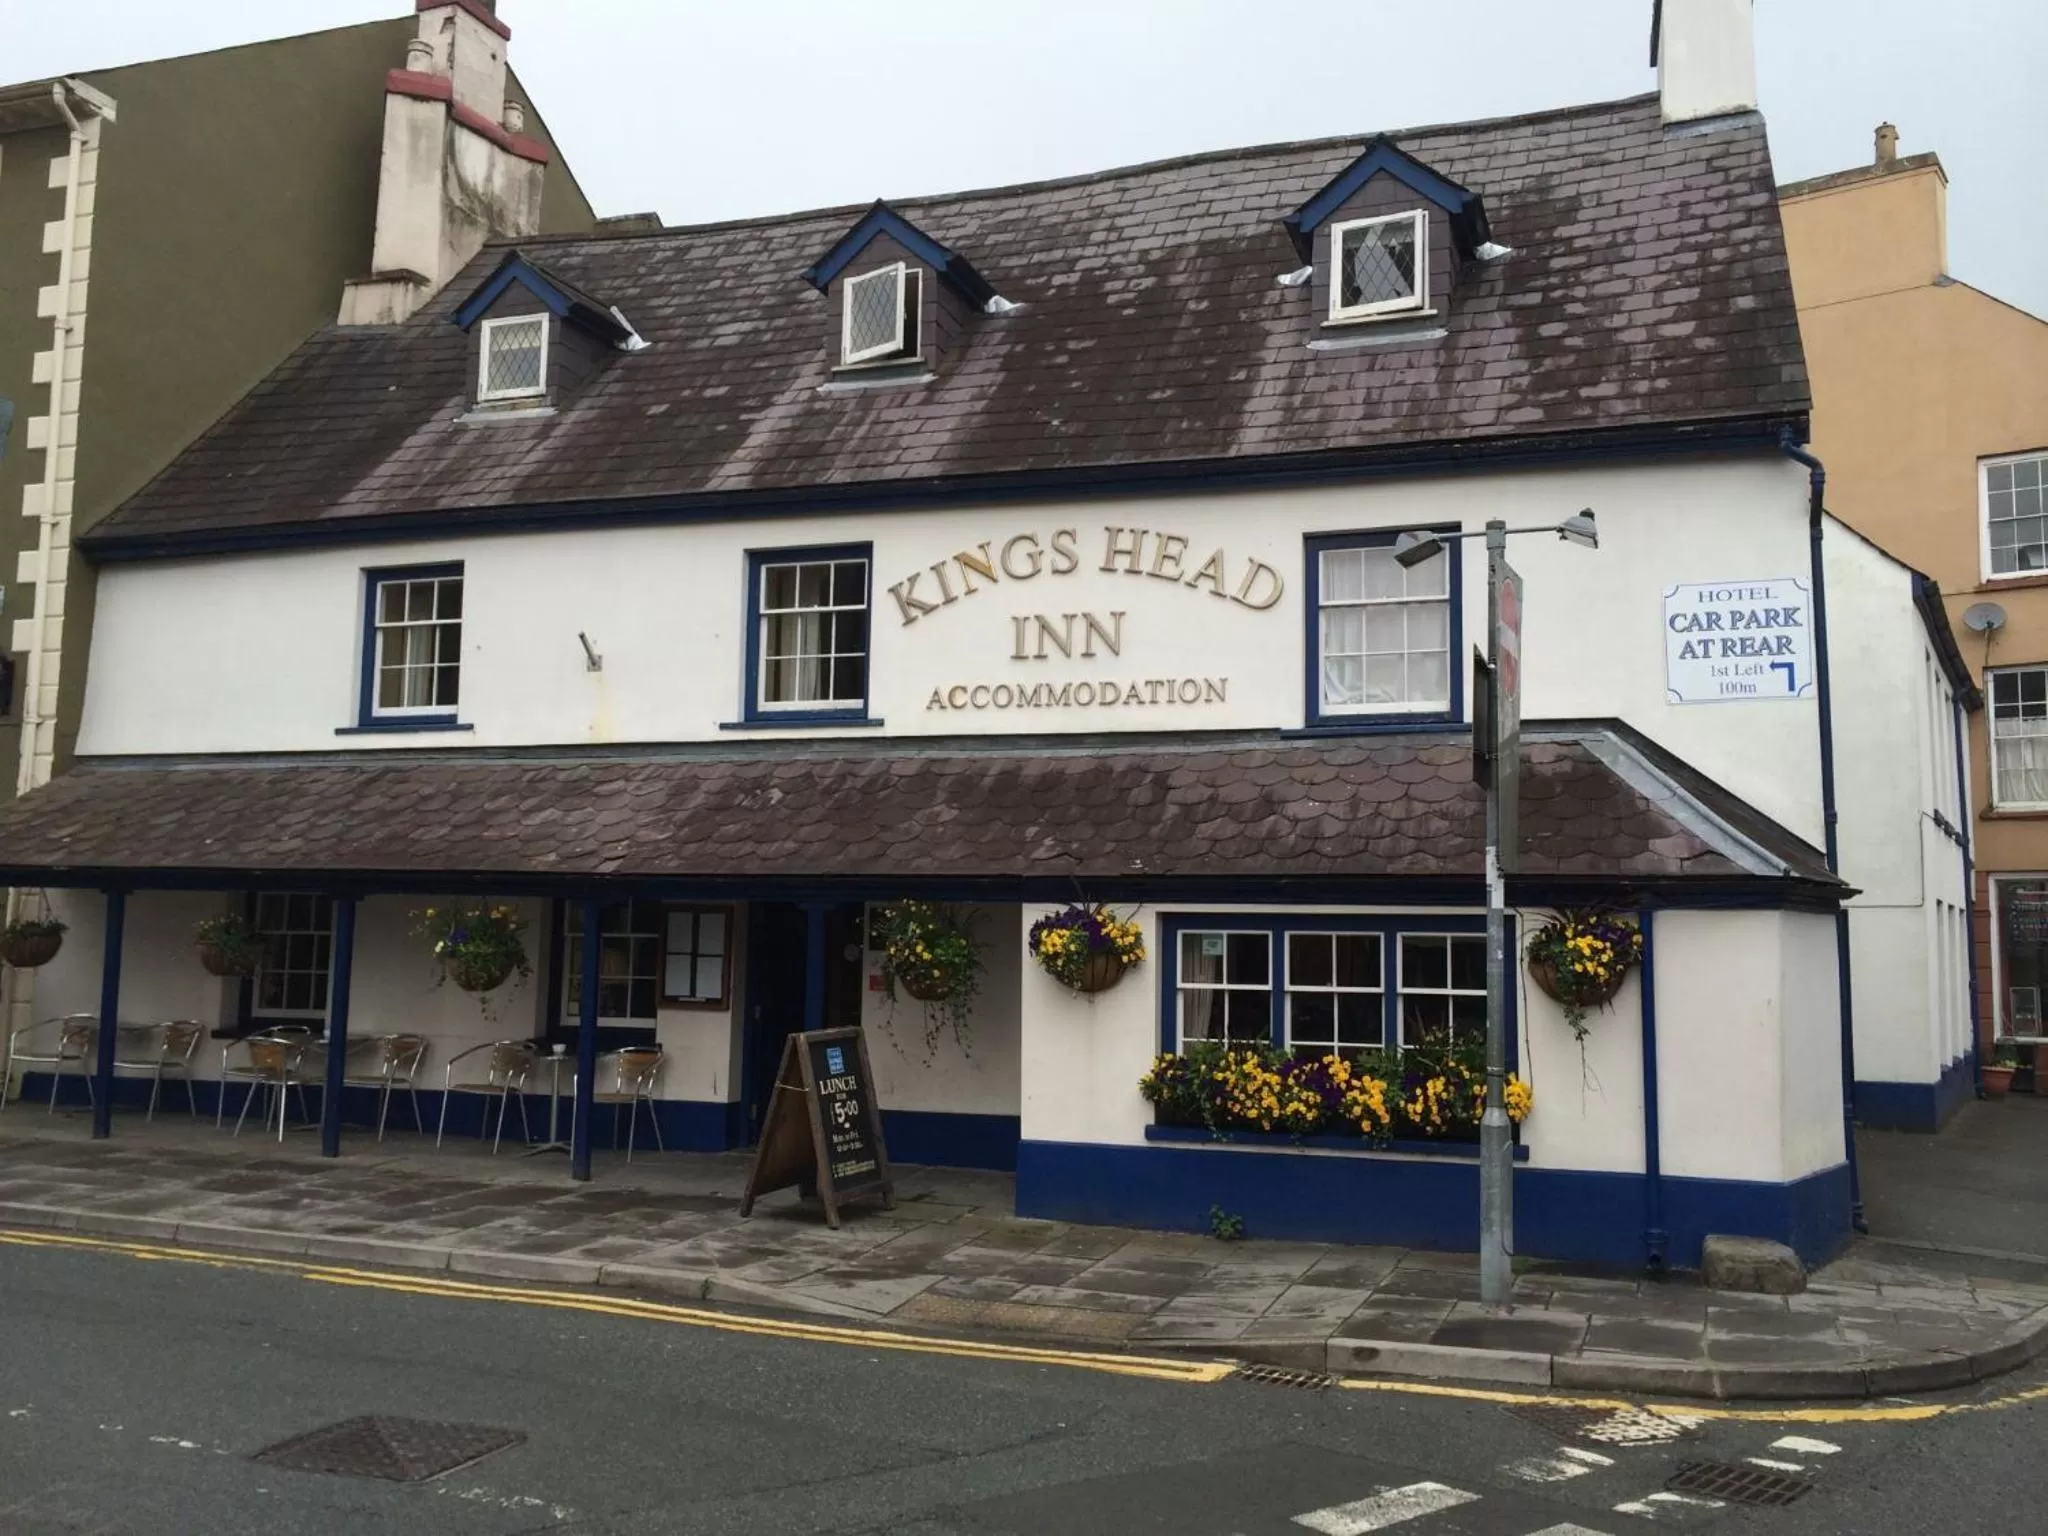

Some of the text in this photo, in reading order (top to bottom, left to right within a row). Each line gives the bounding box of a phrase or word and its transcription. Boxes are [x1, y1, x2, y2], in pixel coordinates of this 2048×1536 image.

[888, 526, 1285, 627] KINGS HEAD
[1698, 587, 1779, 603] HOTEL
[1669, 606, 1803, 633] CAR PARK
[1010, 611, 1126, 660] INN
[1678, 635, 1796, 660] AT REAR
[1734, 663, 1764, 677] Left
[926, 677, 1229, 711] ACCOMMODATION
[1719, 681, 1757, 695] 100m
[819, 1075, 858, 1095] LUNCH
